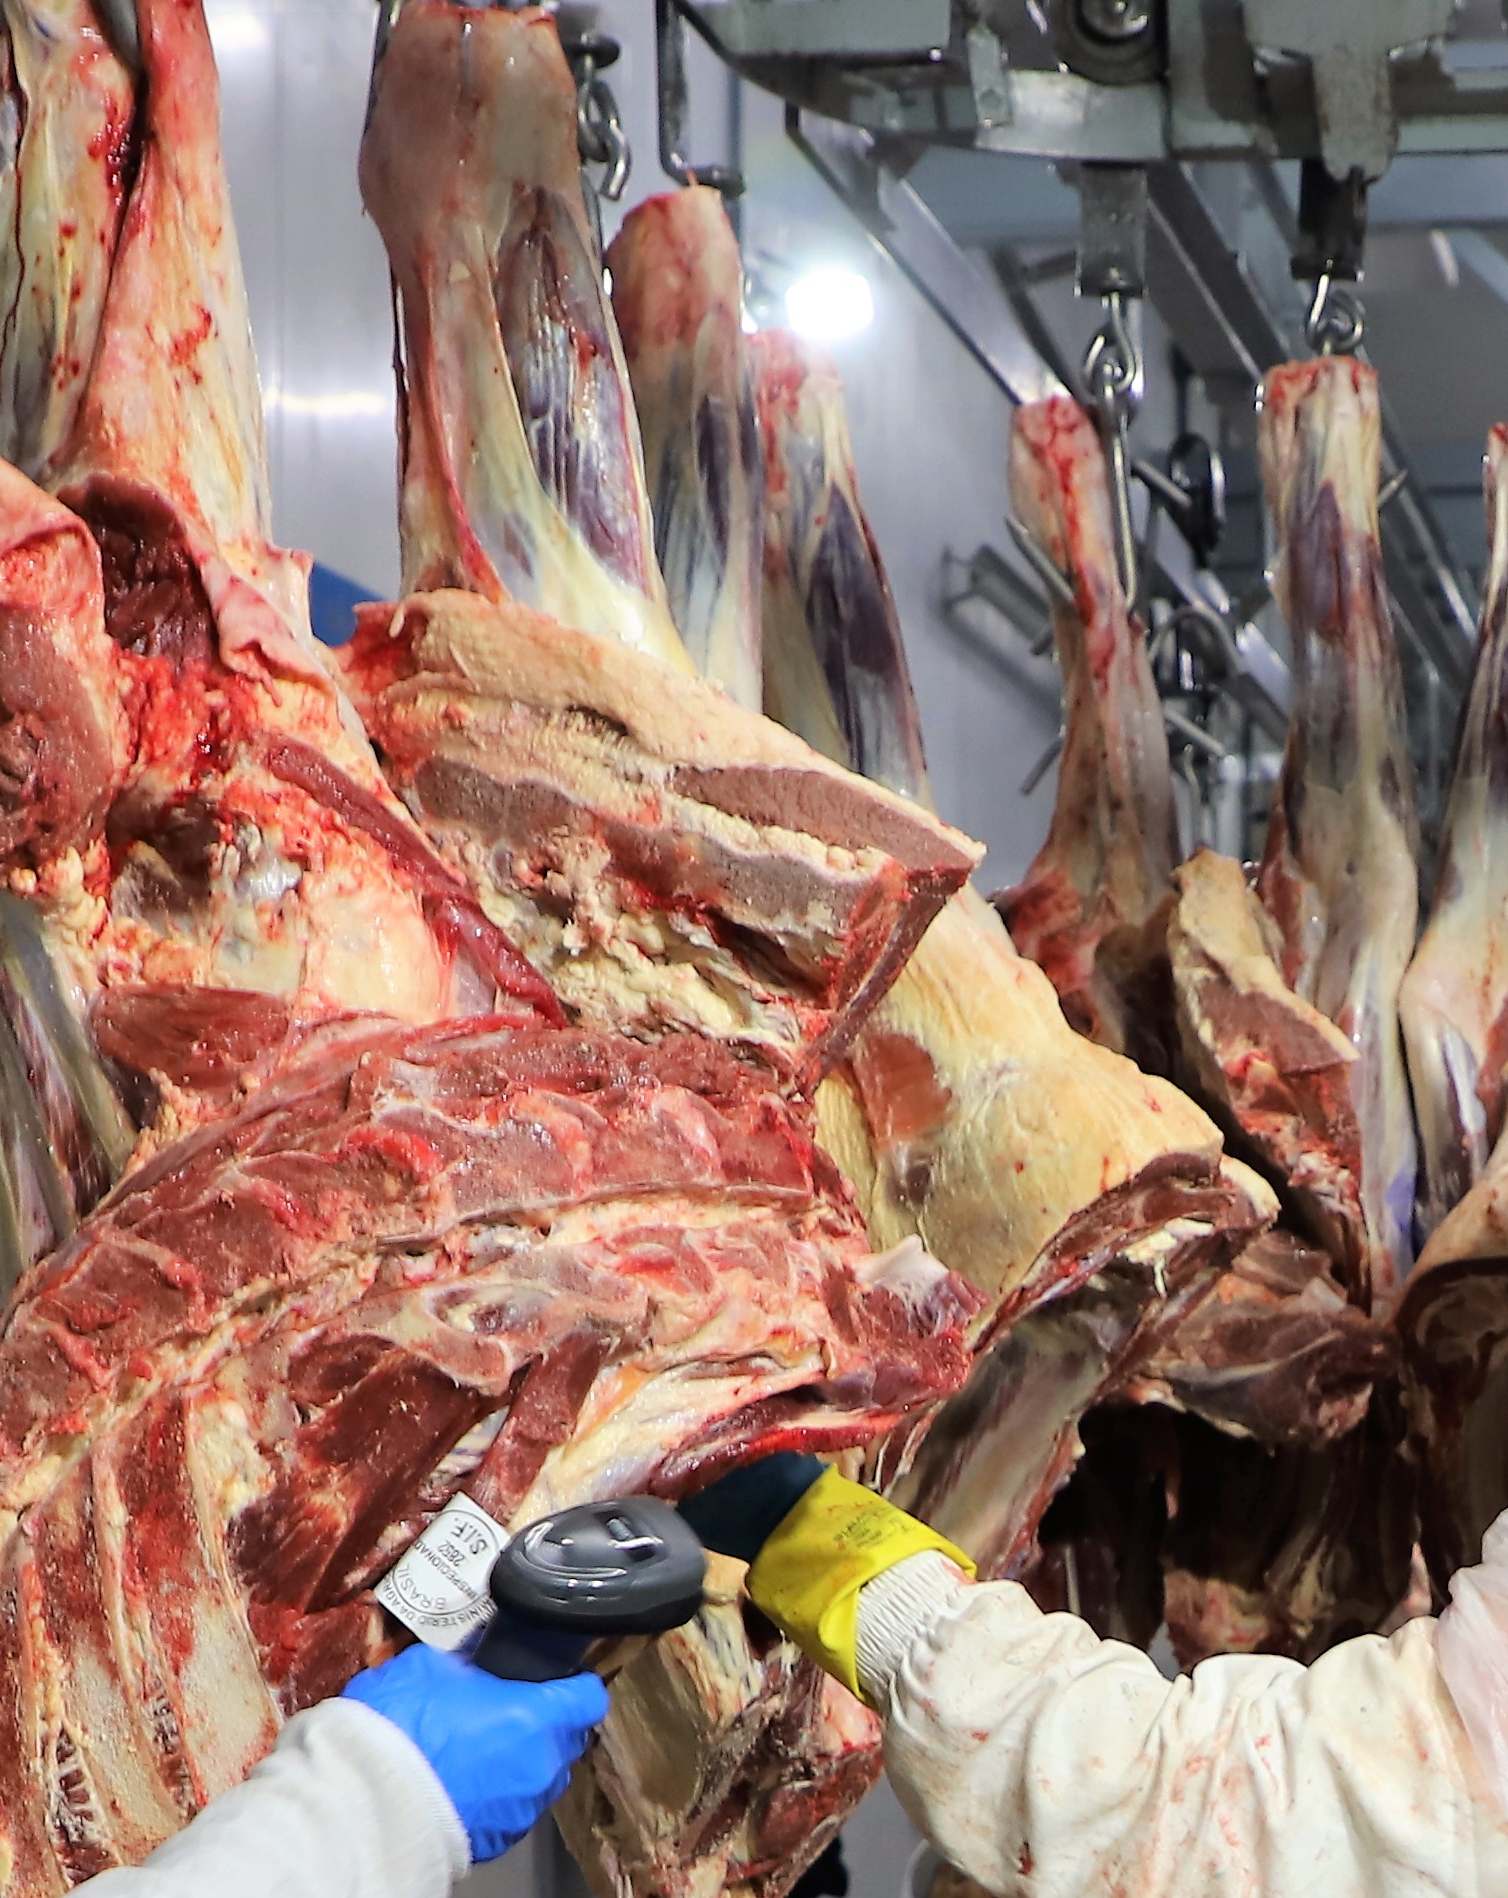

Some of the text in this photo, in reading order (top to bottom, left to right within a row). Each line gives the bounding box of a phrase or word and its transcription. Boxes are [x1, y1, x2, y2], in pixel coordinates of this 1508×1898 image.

[437, 1539, 468, 1567] 2852
[449, 1517, 489, 1555] S.I.F.
[397, 1563, 447, 1611] BRASIL
[414, 1540, 478, 1600] INSPECIONAD
